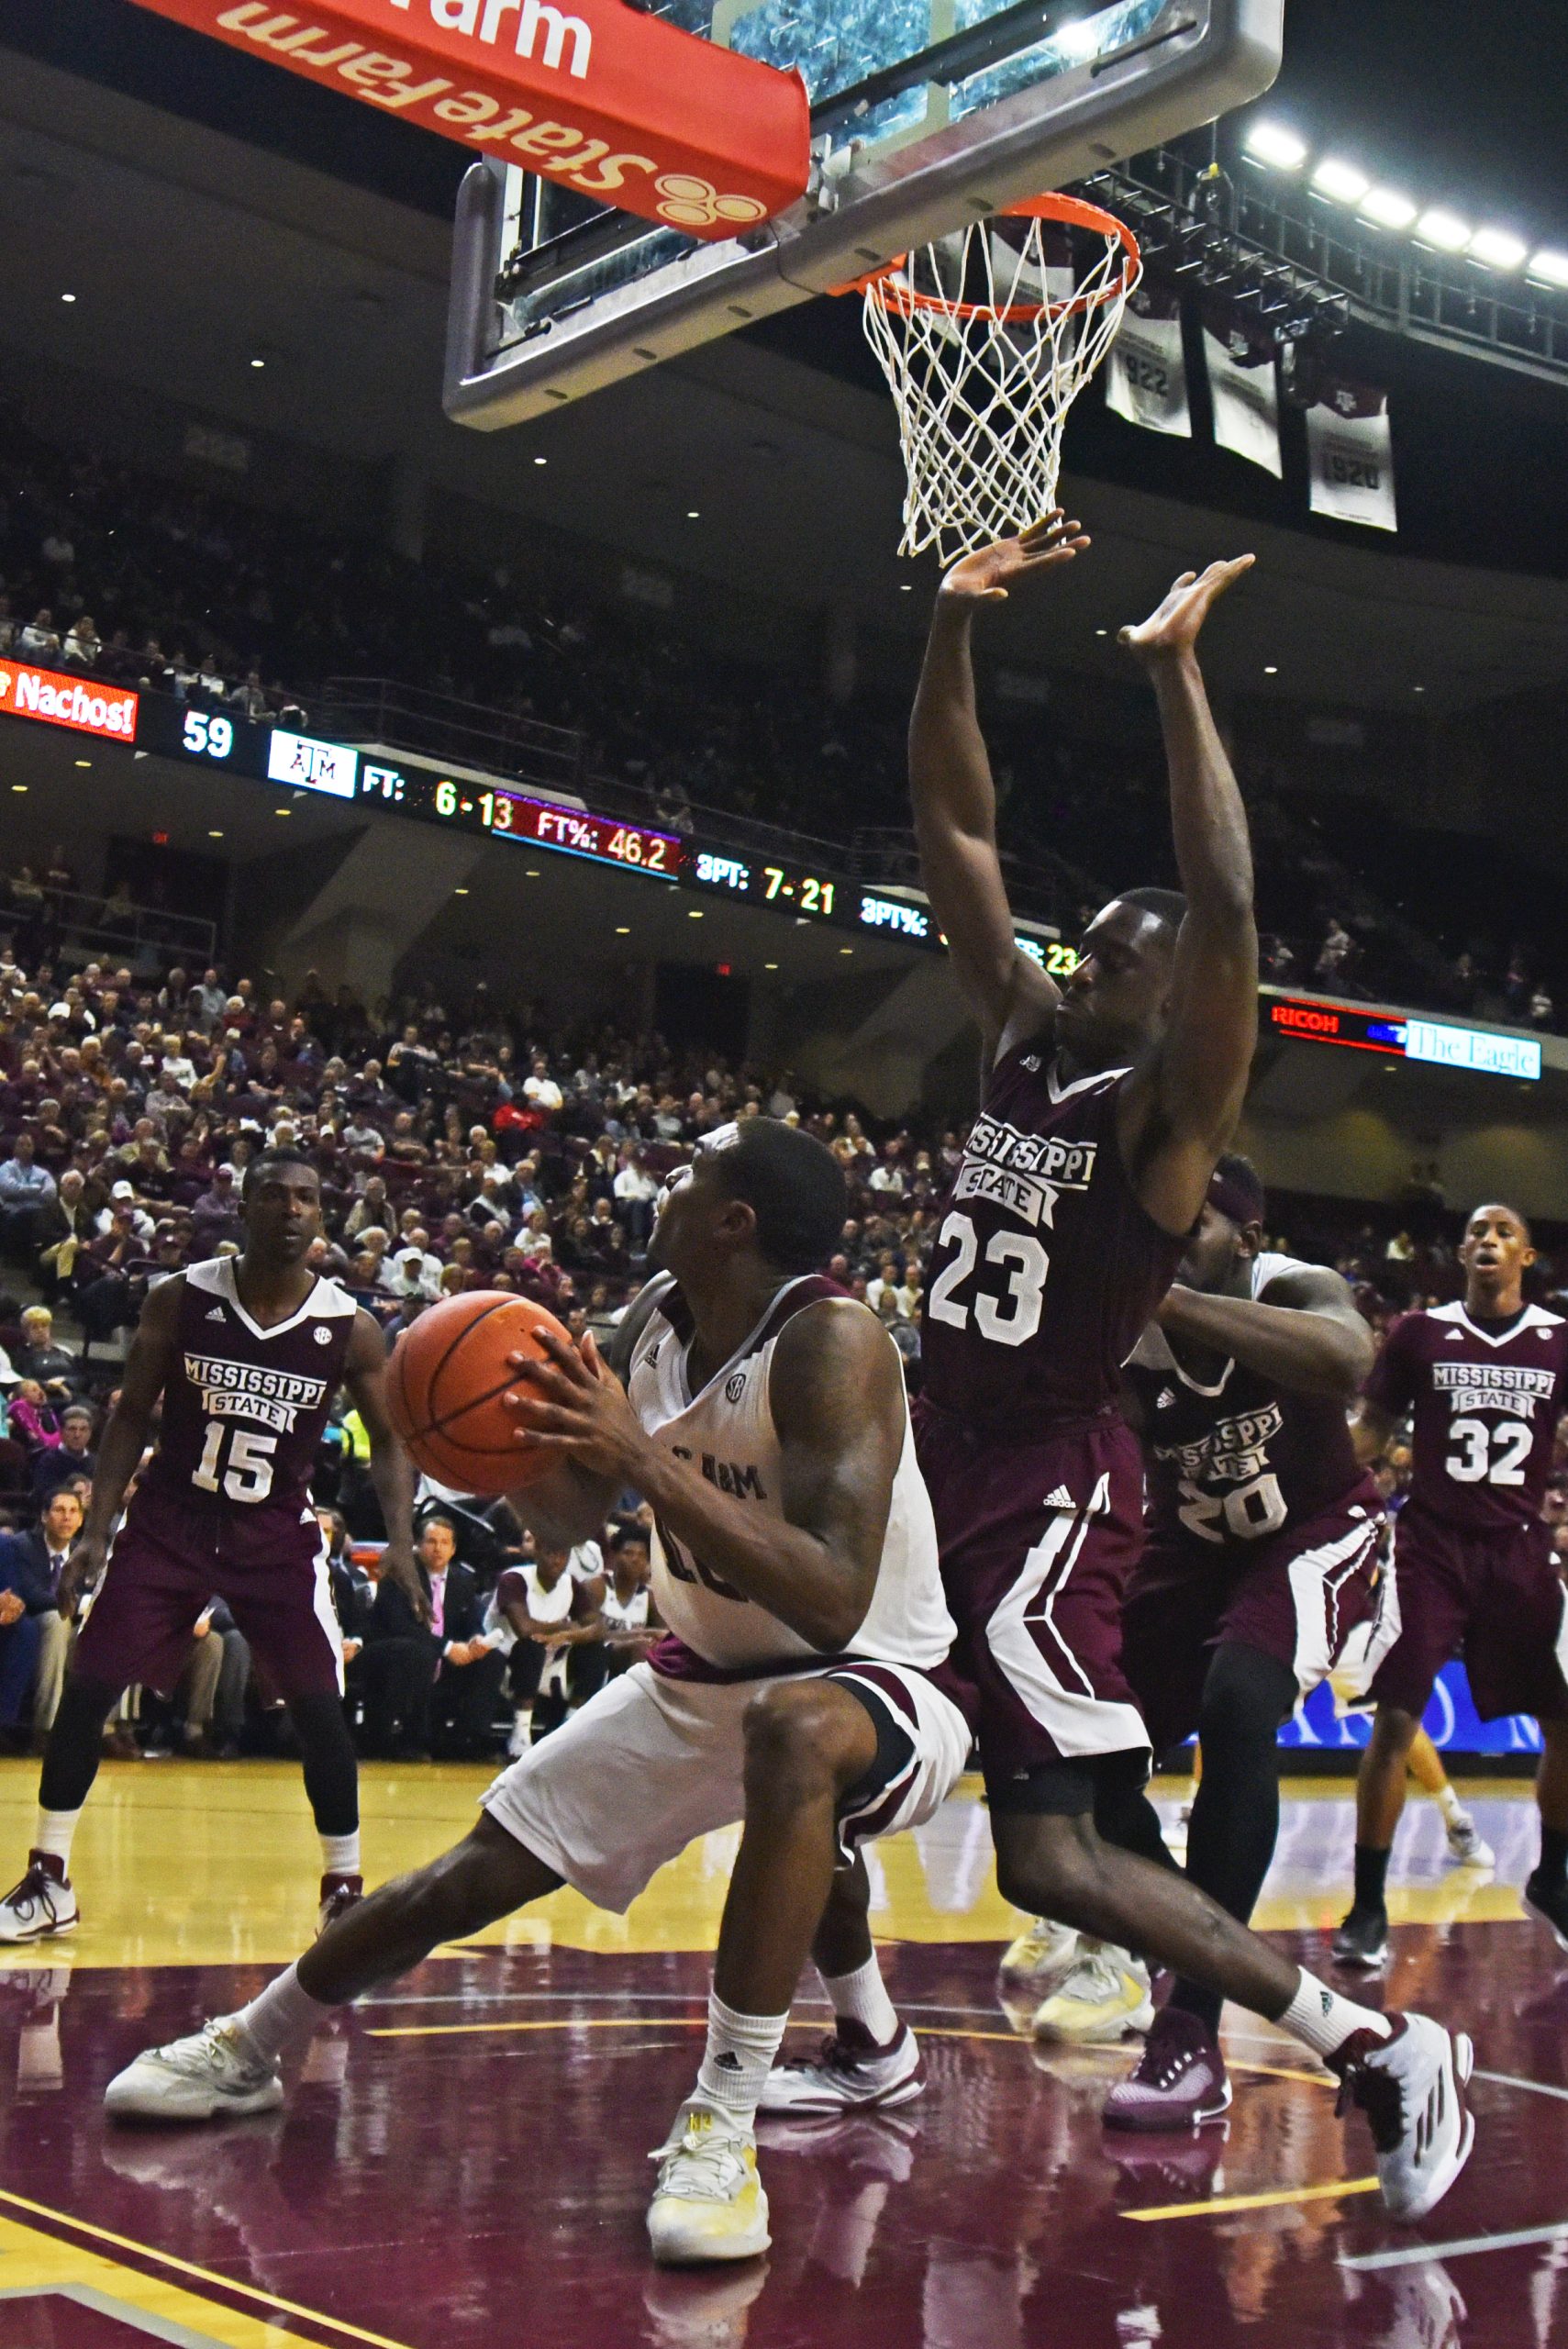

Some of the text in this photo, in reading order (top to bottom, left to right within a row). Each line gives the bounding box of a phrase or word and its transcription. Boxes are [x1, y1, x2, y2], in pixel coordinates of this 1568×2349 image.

[389, 0, 592, 80] arm
[15, 671, 135, 734] Nachos!
[183, 709, 233, 758] 59
[362, 764, 406, 801] FT:
[537, 811, 598, 851] FT%:
[608, 829, 665, 870] 46.2
[696, 853, 750, 890] 3PT:
[861, 897, 929, 937] 3PT%:
[1271, 1006, 1339, 1033] RICOH
[1413, 1025, 1535, 1075] The Eagle
[966, 1168, 1031, 1213] STATE
[929, 1210, 1050, 1346] 23
[184, 1357, 327, 1406] MISSISSIPPI
[1433, 1367, 1555, 1395] MISSISSIPPI
[1466, 1392, 1520, 1411] STATE
[215, 1396, 281, 1425] STATE
[192, 1420, 278, 1503] 15
[1446, 1419, 1533, 1485] 32
[1178, 1473, 1288, 1544] 20
